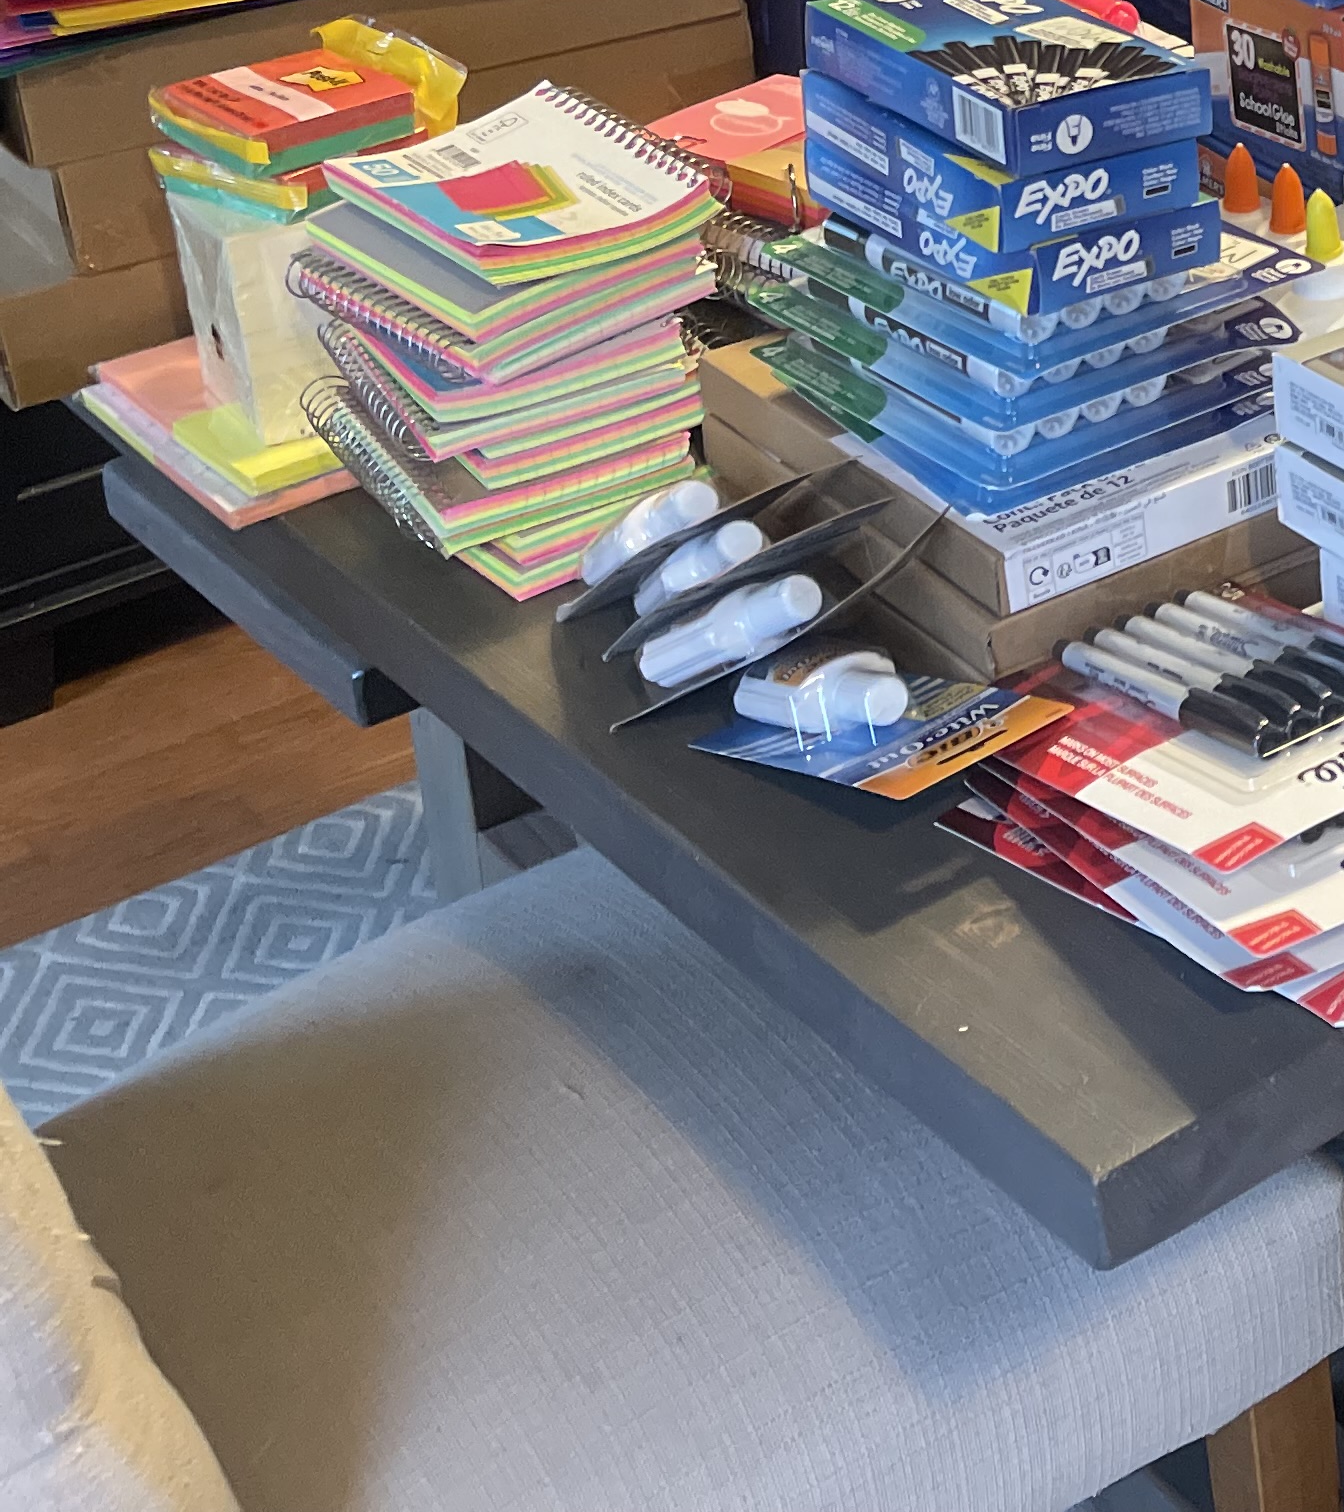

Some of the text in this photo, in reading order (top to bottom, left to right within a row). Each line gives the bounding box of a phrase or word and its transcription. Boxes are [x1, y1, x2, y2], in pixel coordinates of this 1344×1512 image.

[1230, 29, 1256, 70] 30
[902, 168, 954, 217] EXPO
[1014, 168, 1111, 225] EXPO
[919, 231, 977, 279] EXPO
[1052, 229, 1142, 287] EXPO
[991, 474, 1136, 534] Paquete de 12
